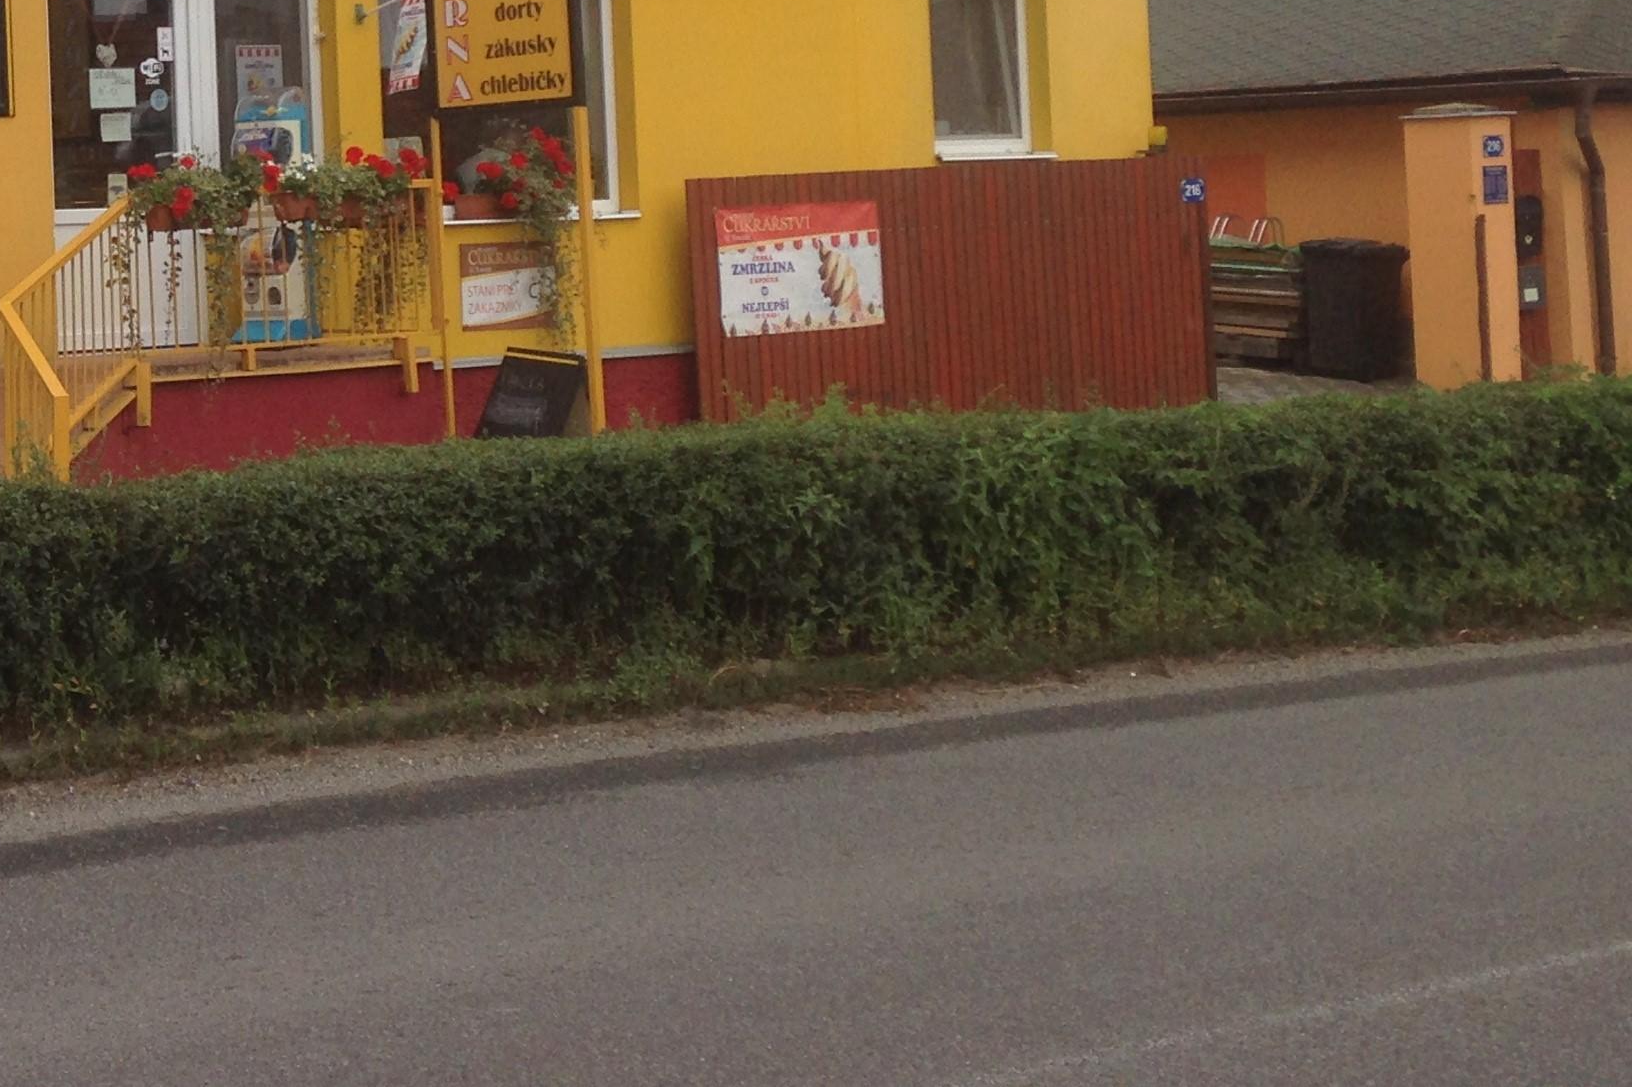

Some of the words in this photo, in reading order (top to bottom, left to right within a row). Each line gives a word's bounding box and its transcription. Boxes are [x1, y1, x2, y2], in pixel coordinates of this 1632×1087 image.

[485, 33, 558, 61] zákusky
[731, 260, 796, 276] ZMRZLINA
[742, 297, 790, 314] NEJLEPŠÍ
